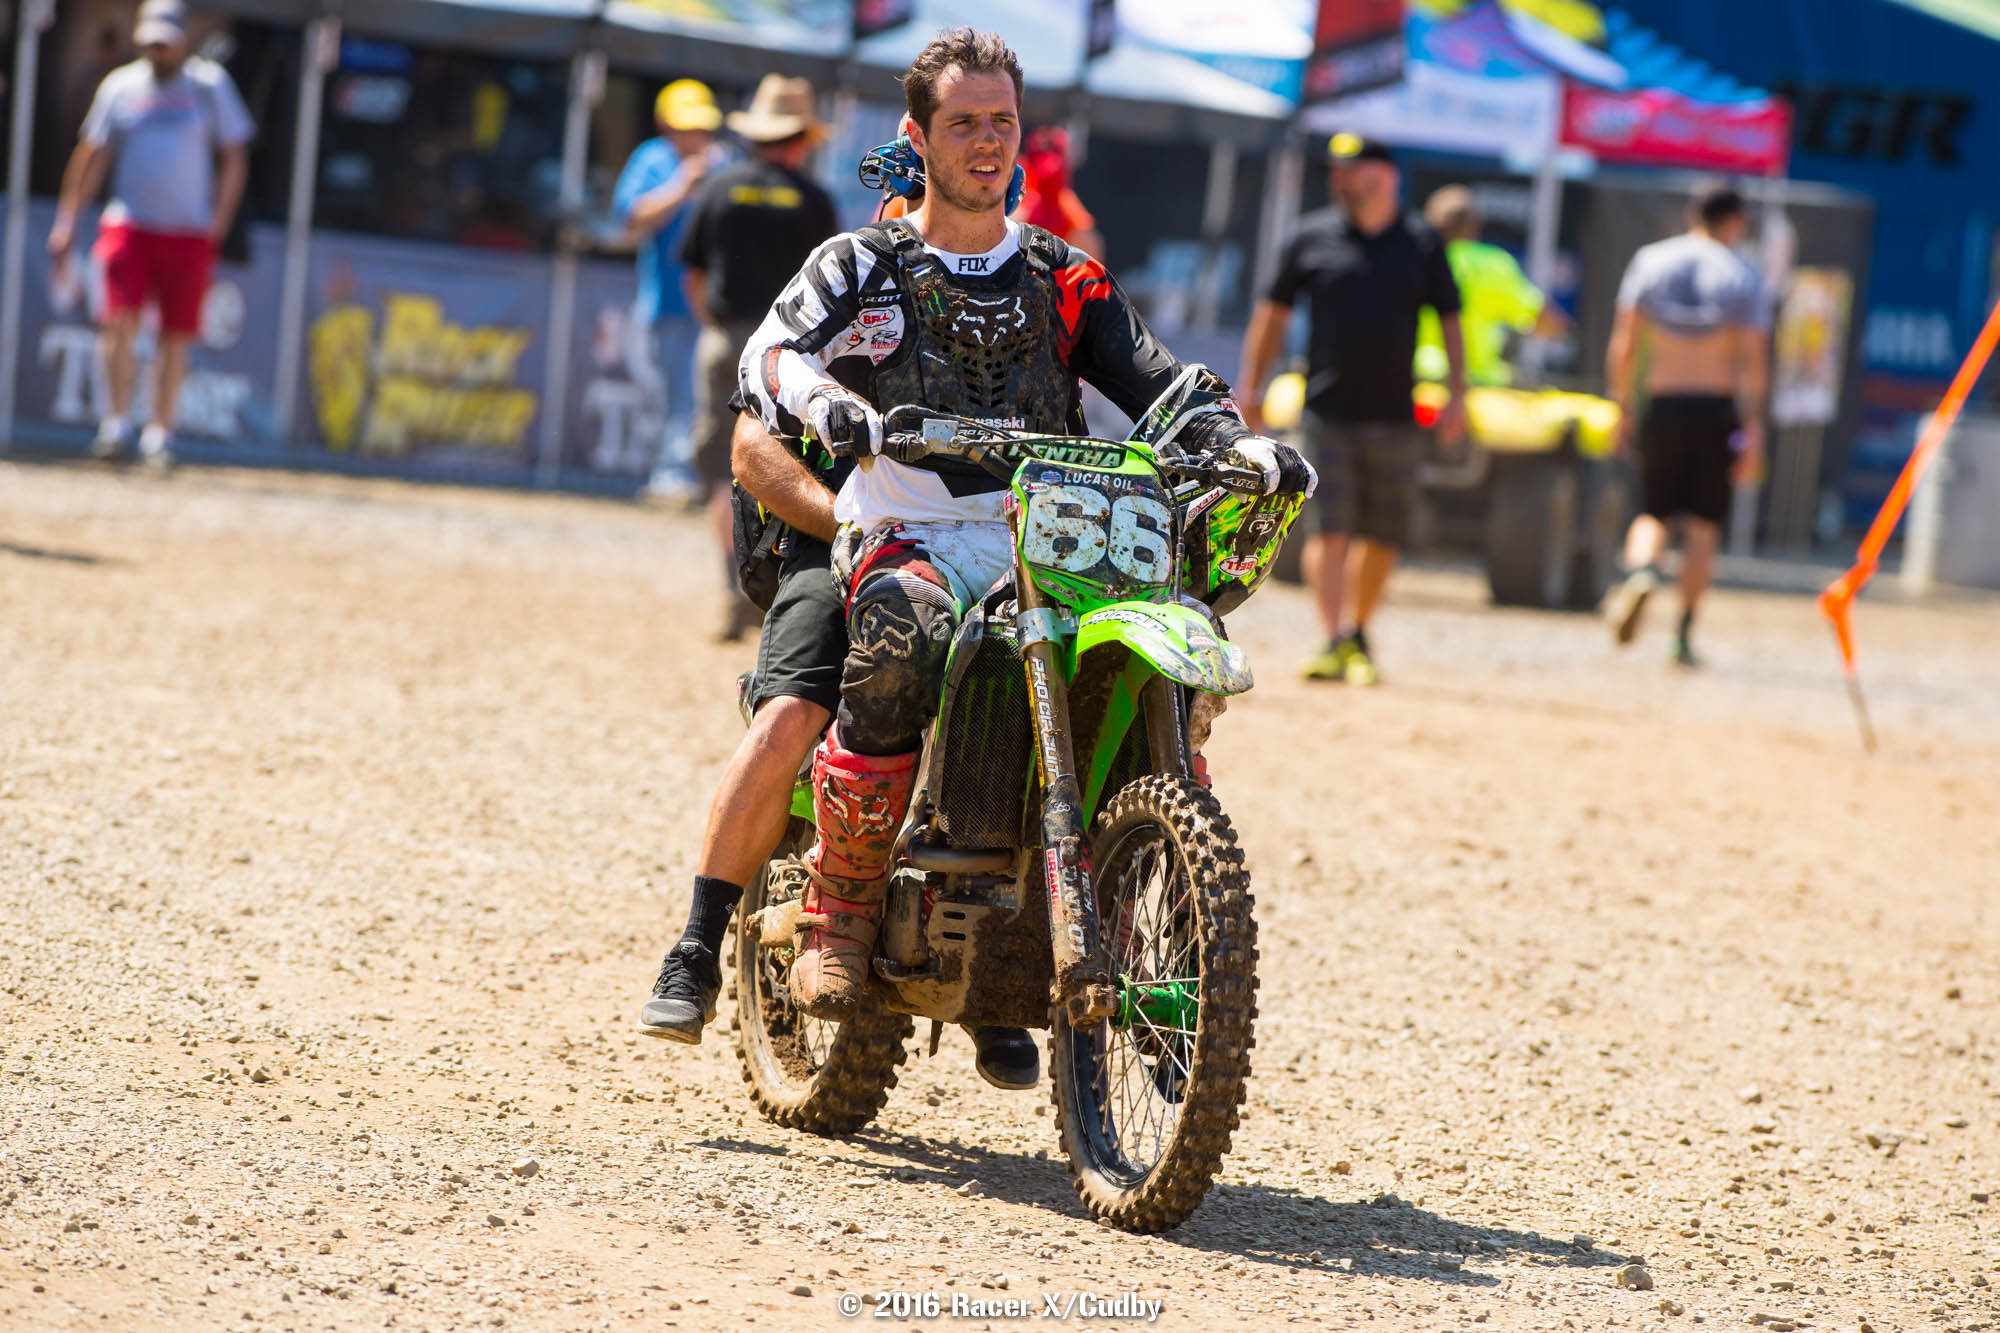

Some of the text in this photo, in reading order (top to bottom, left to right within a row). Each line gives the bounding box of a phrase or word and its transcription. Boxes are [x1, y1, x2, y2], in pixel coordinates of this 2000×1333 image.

[959, 257, 990, 272] FOX
[1063, 472, 1110, 487] LUCAS
[1113, 477, 1133, 491] OIL
[1023, 485, 1173, 584] 66
[1226, 560, 1255, 572] BELL
[1031, 657, 1049, 700] PRO
